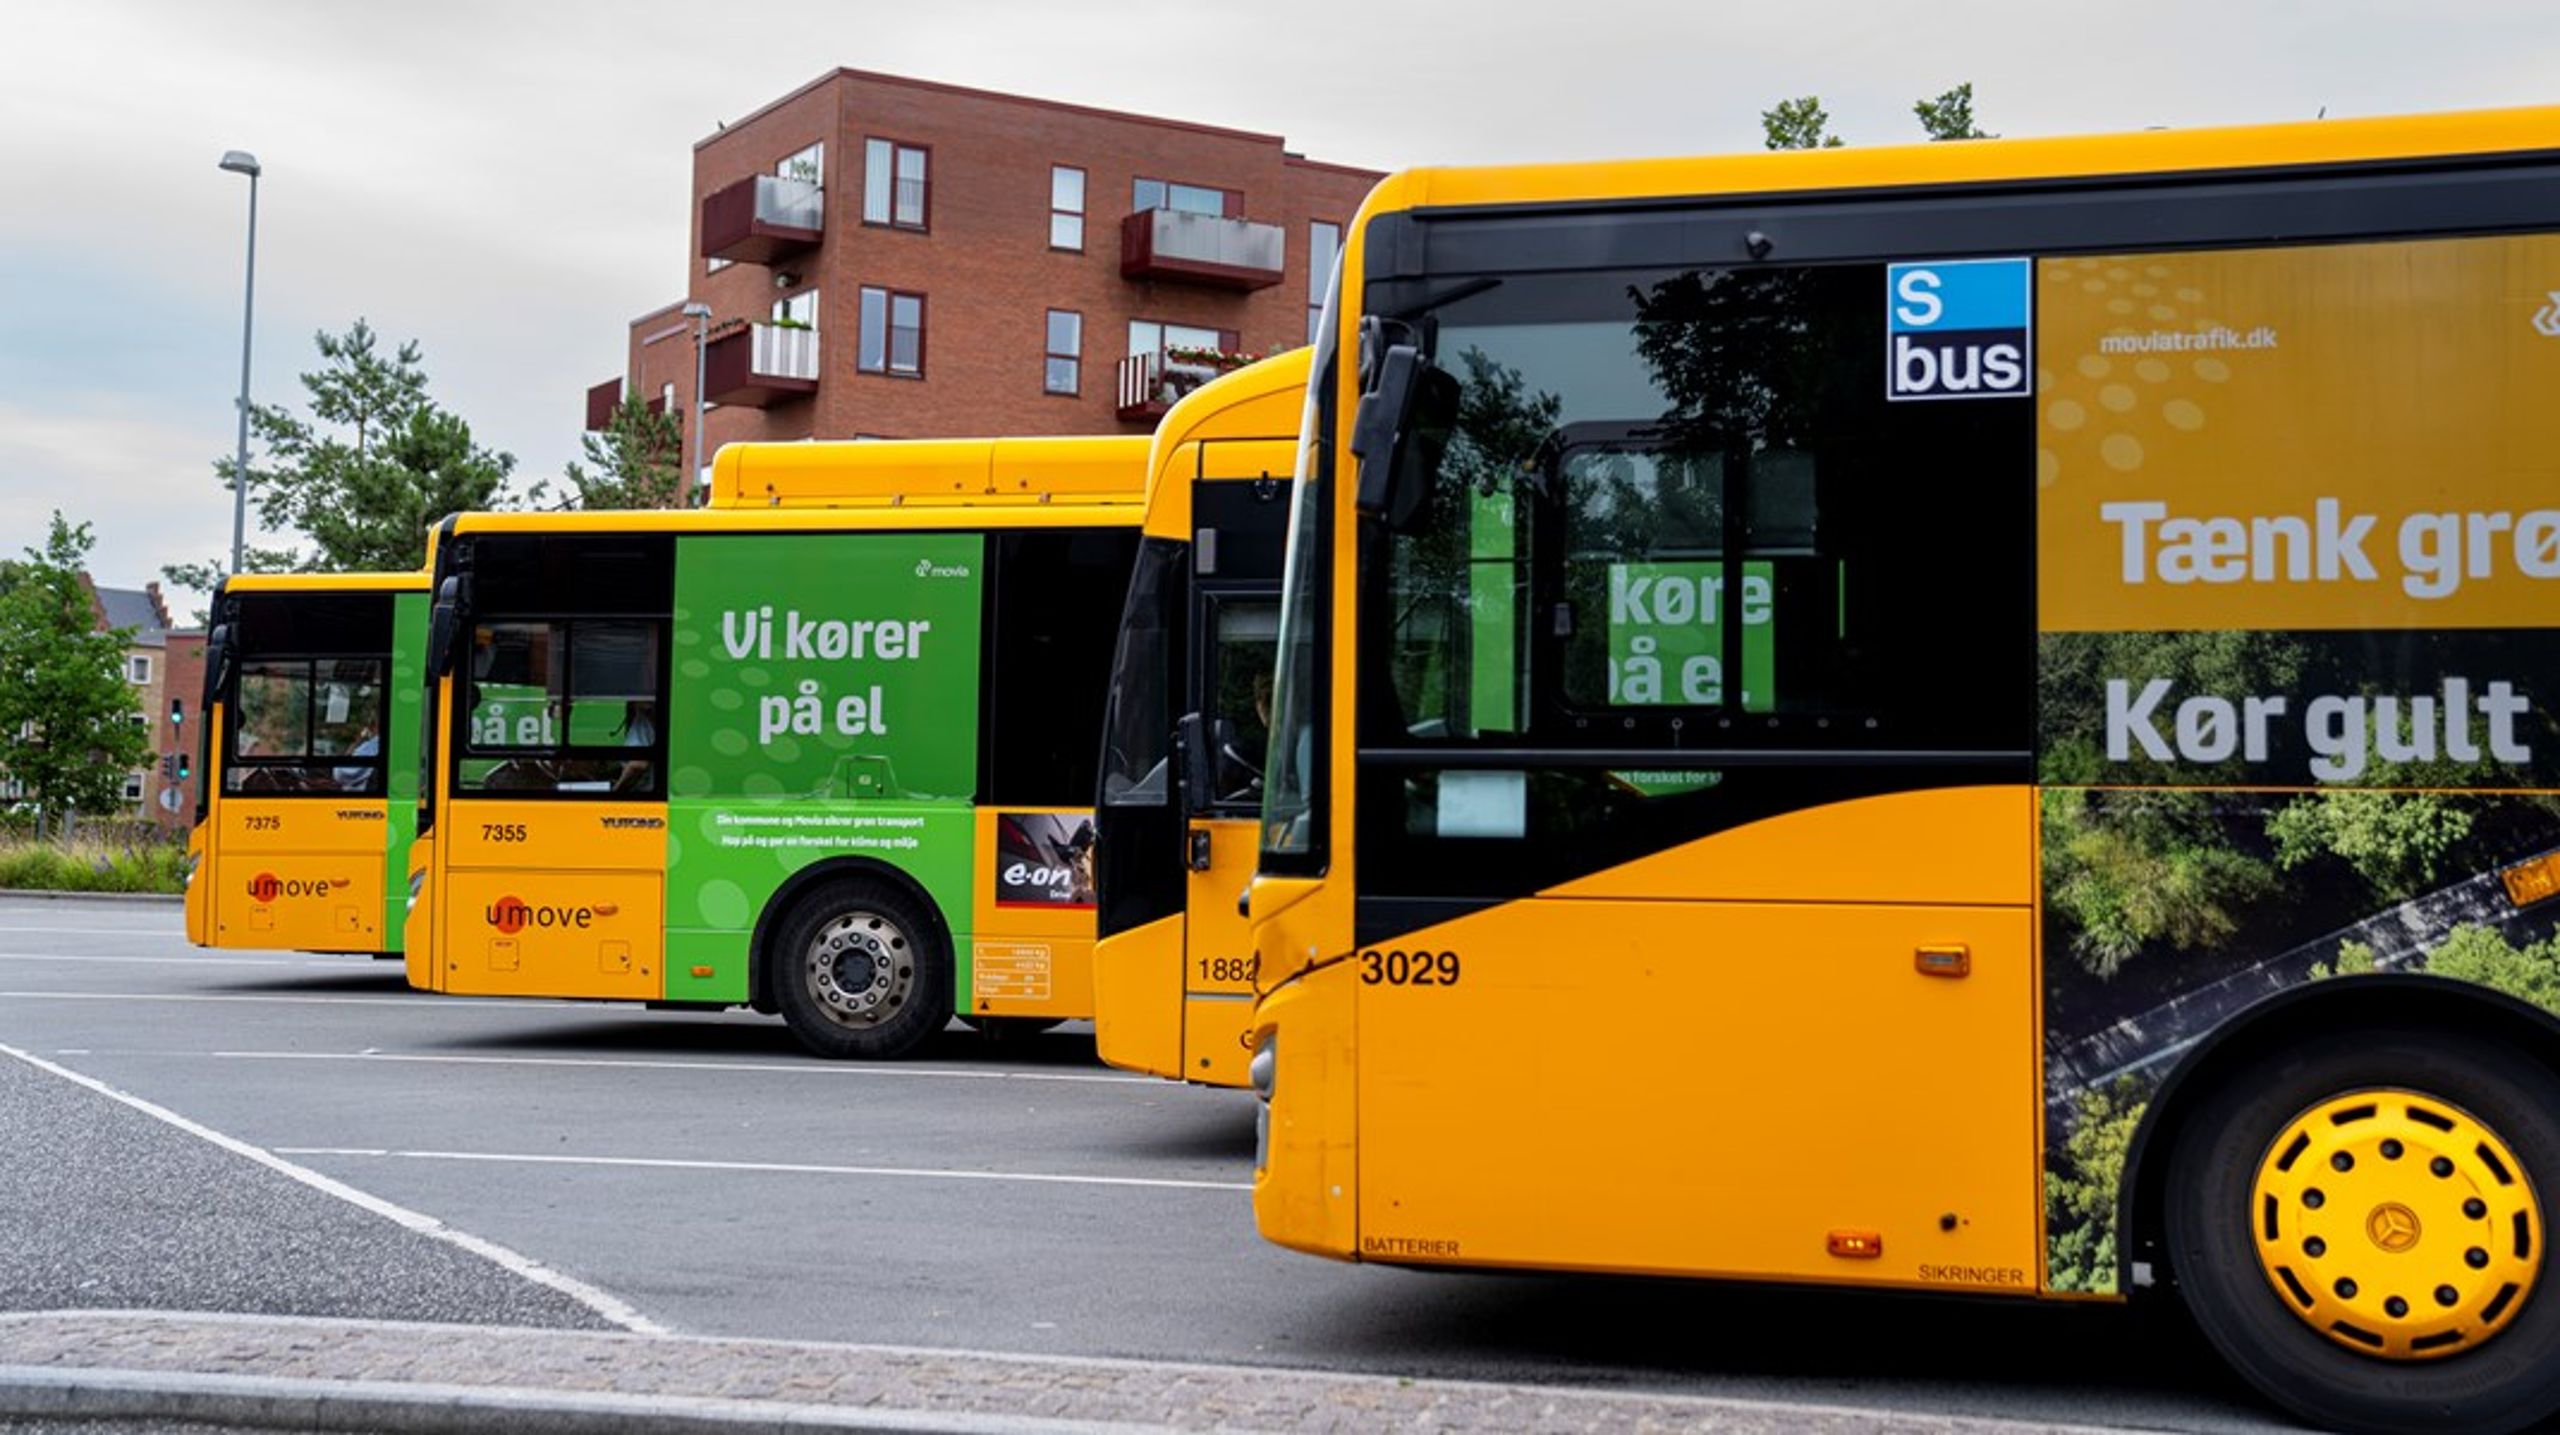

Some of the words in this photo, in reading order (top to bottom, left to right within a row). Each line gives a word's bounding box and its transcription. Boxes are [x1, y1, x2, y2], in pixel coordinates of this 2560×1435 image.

[1896, 269, 1943, 327] S
[1896, 335, 2022, 393] bus
[2101, 326, 2278, 355] moviatrafik.dk
[2101, 497, 2379, 584] Tænk
[722, 606, 772, 660] Vi
[786, 611, 931, 660] kører
[1610, 635, 1662, 704] å
[759, 678, 822, 745] på
[836, 686, 887, 735] el
[2106, 678, 2286, 762] Kør
[2305, 676, 2531, 782] gult
[245, 815, 281, 831] 7375
[481, 824, 528, 842] 7355
[1360, 950, 1460, 986] 3029
[1363, 1237, 1460, 1256] BATTERIER
[1918, 1264, 2024, 1283] SIKRINGER
